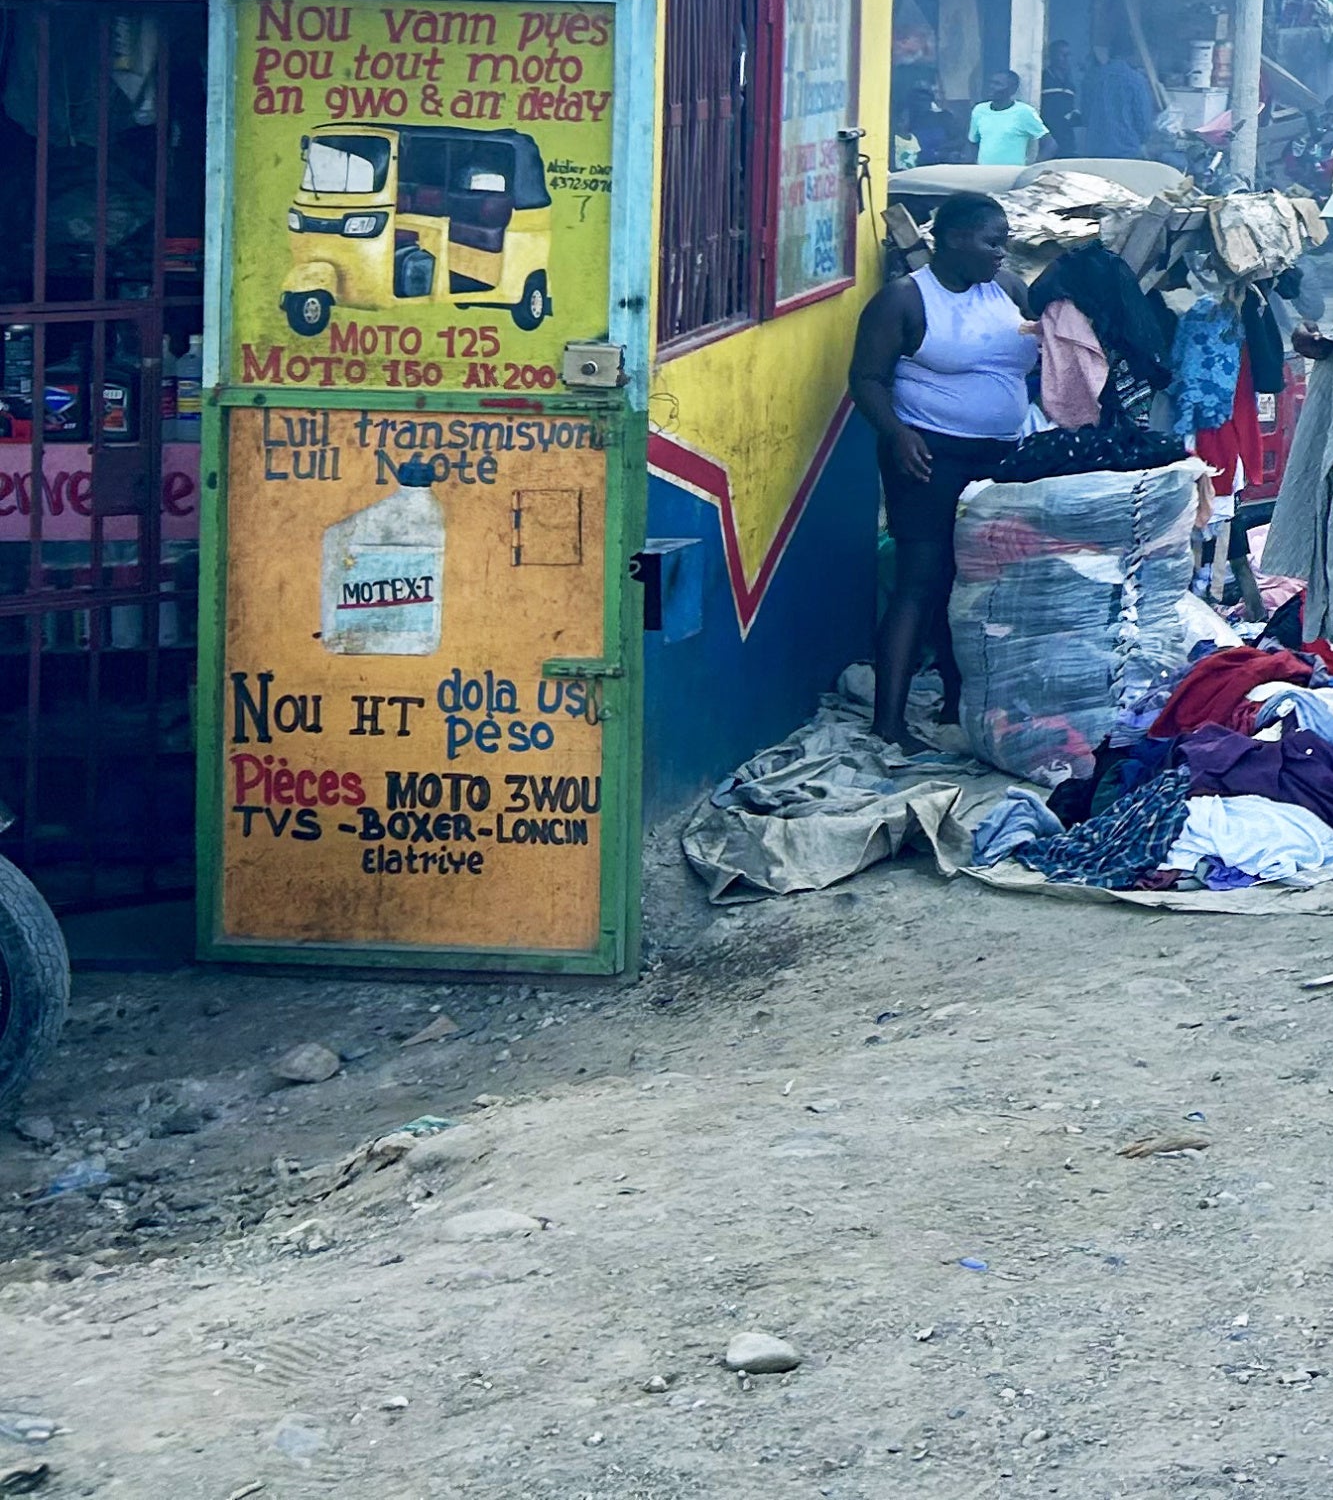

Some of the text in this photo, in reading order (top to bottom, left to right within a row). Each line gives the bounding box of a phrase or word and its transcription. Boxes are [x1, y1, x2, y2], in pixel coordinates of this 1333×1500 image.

[254, 0, 353, 42] Nou
[380, 7, 497, 45] vann
[253, 45, 584, 86] pou tout moto
[253, 84, 305, 115] an
[325, 84, 408, 119] gwo
[420, 83, 444, 117] &
[449, 89, 506, 119] an
[330, 321, 501, 358] MOTO 125
[382, 359, 443, 387] 150
[263, 407, 608, 452] Luil transmisyon
[230, 671, 425, 743] Nou HT
[436, 668, 521, 715] dola
[444, 712, 555, 760] pèso
[231, 753, 602, 814] Pièces MOTO 3WOU
[232, 806, 323, 841] TVS
